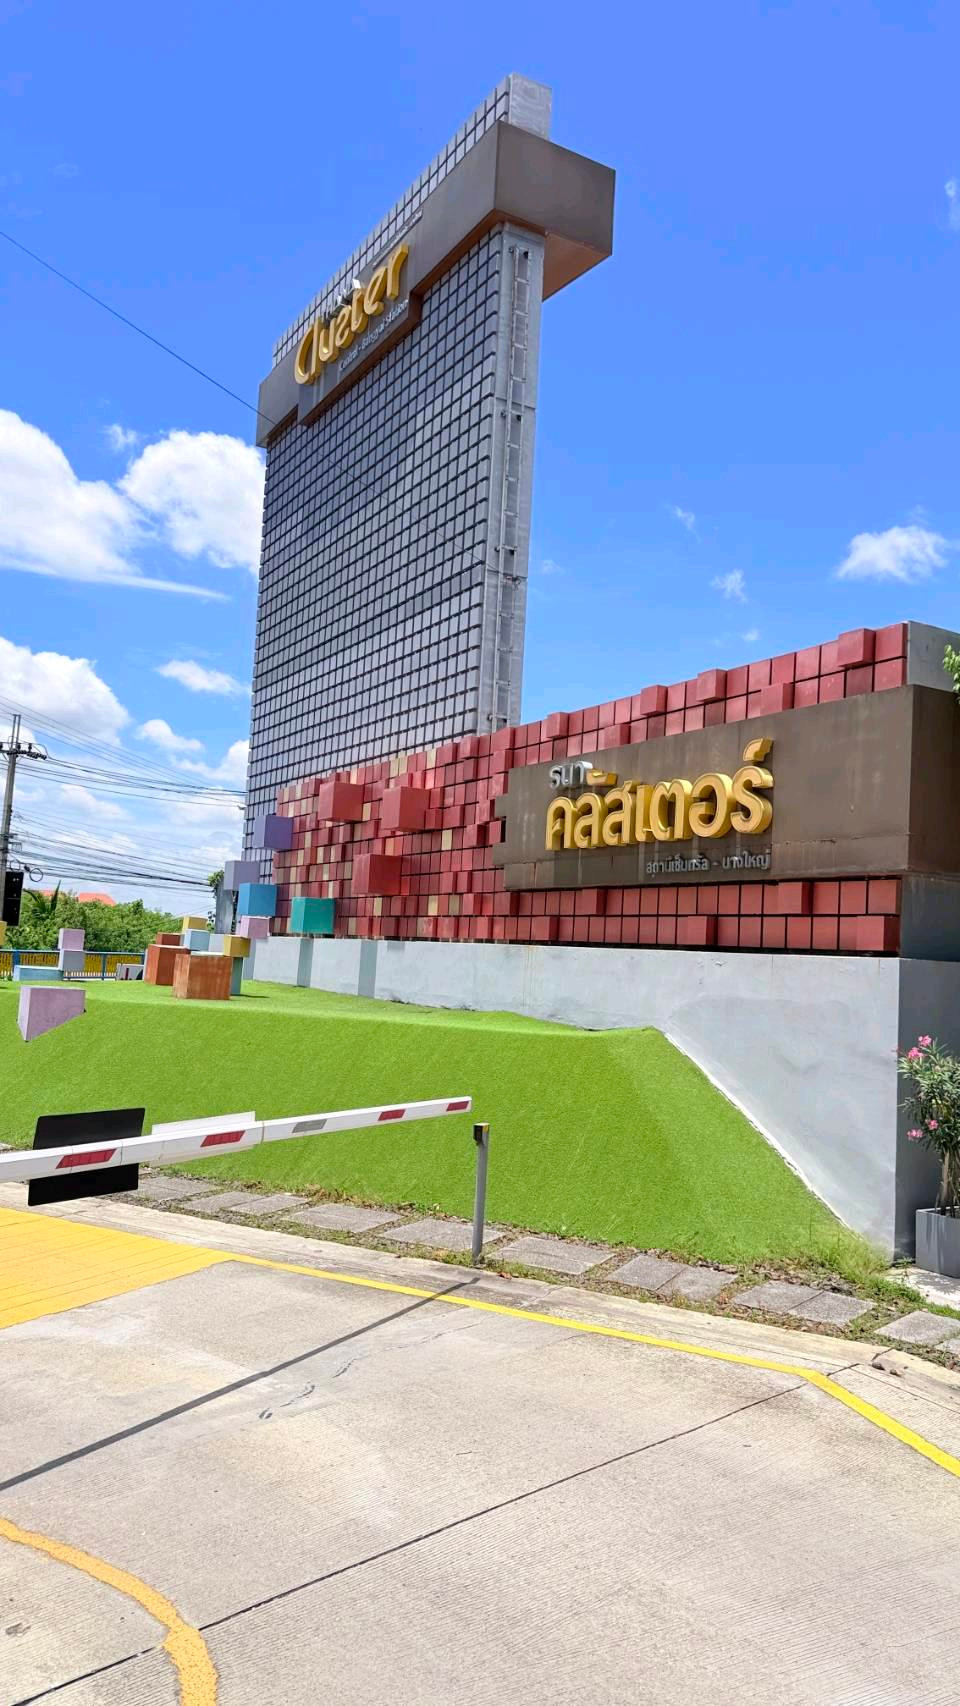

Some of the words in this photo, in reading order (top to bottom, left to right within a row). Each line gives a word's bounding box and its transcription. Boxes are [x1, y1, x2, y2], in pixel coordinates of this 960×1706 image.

[294, 243, 409, 385] Cluster
[546, 737, 774, 851] คลัสเตอร์
